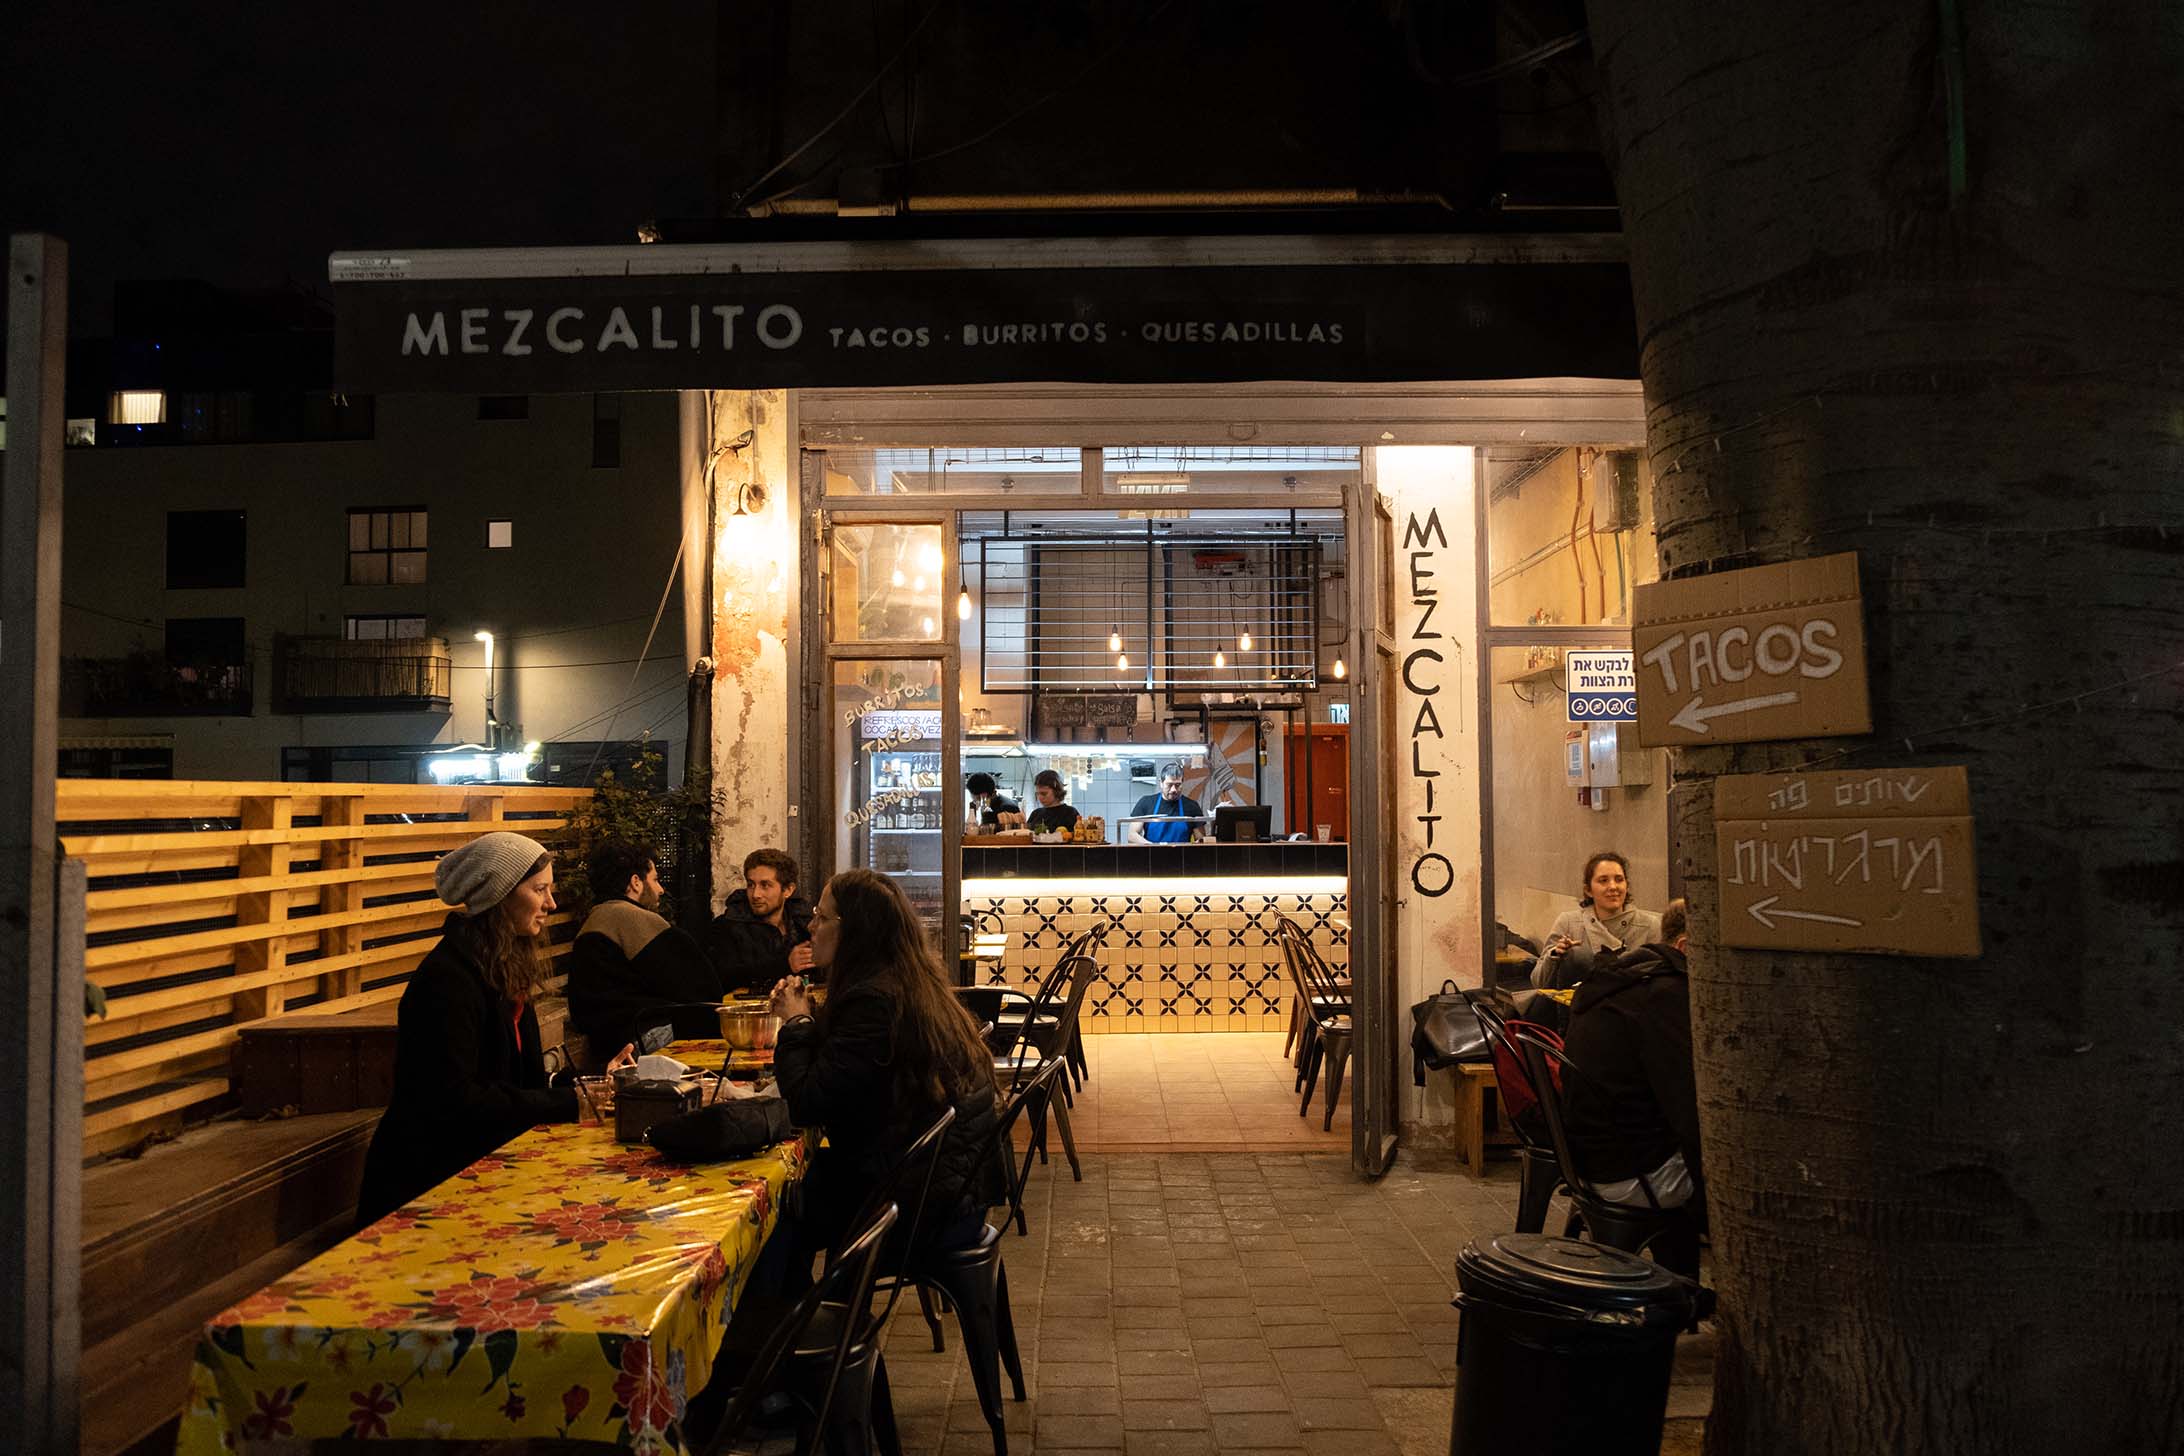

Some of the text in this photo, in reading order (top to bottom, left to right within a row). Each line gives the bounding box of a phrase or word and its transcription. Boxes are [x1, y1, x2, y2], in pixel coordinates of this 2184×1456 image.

[401, 303, 803, 356] MEZCALITO
[828, 320, 1345, 349] TACOS BURRITOS QUESADILLAS
[1573, 657, 1629, 673] לבקש את
[1642, 619, 1843, 693] TACOS
[1580, 675, 1634, 687] רת הצוות
[1403, 507, 1454, 897] MEZCALITO
[861, 726, 923, 755] TACOS
[1768, 776, 1934, 810] שותים פה
[1728, 825, 1943, 894] מרגריטות
